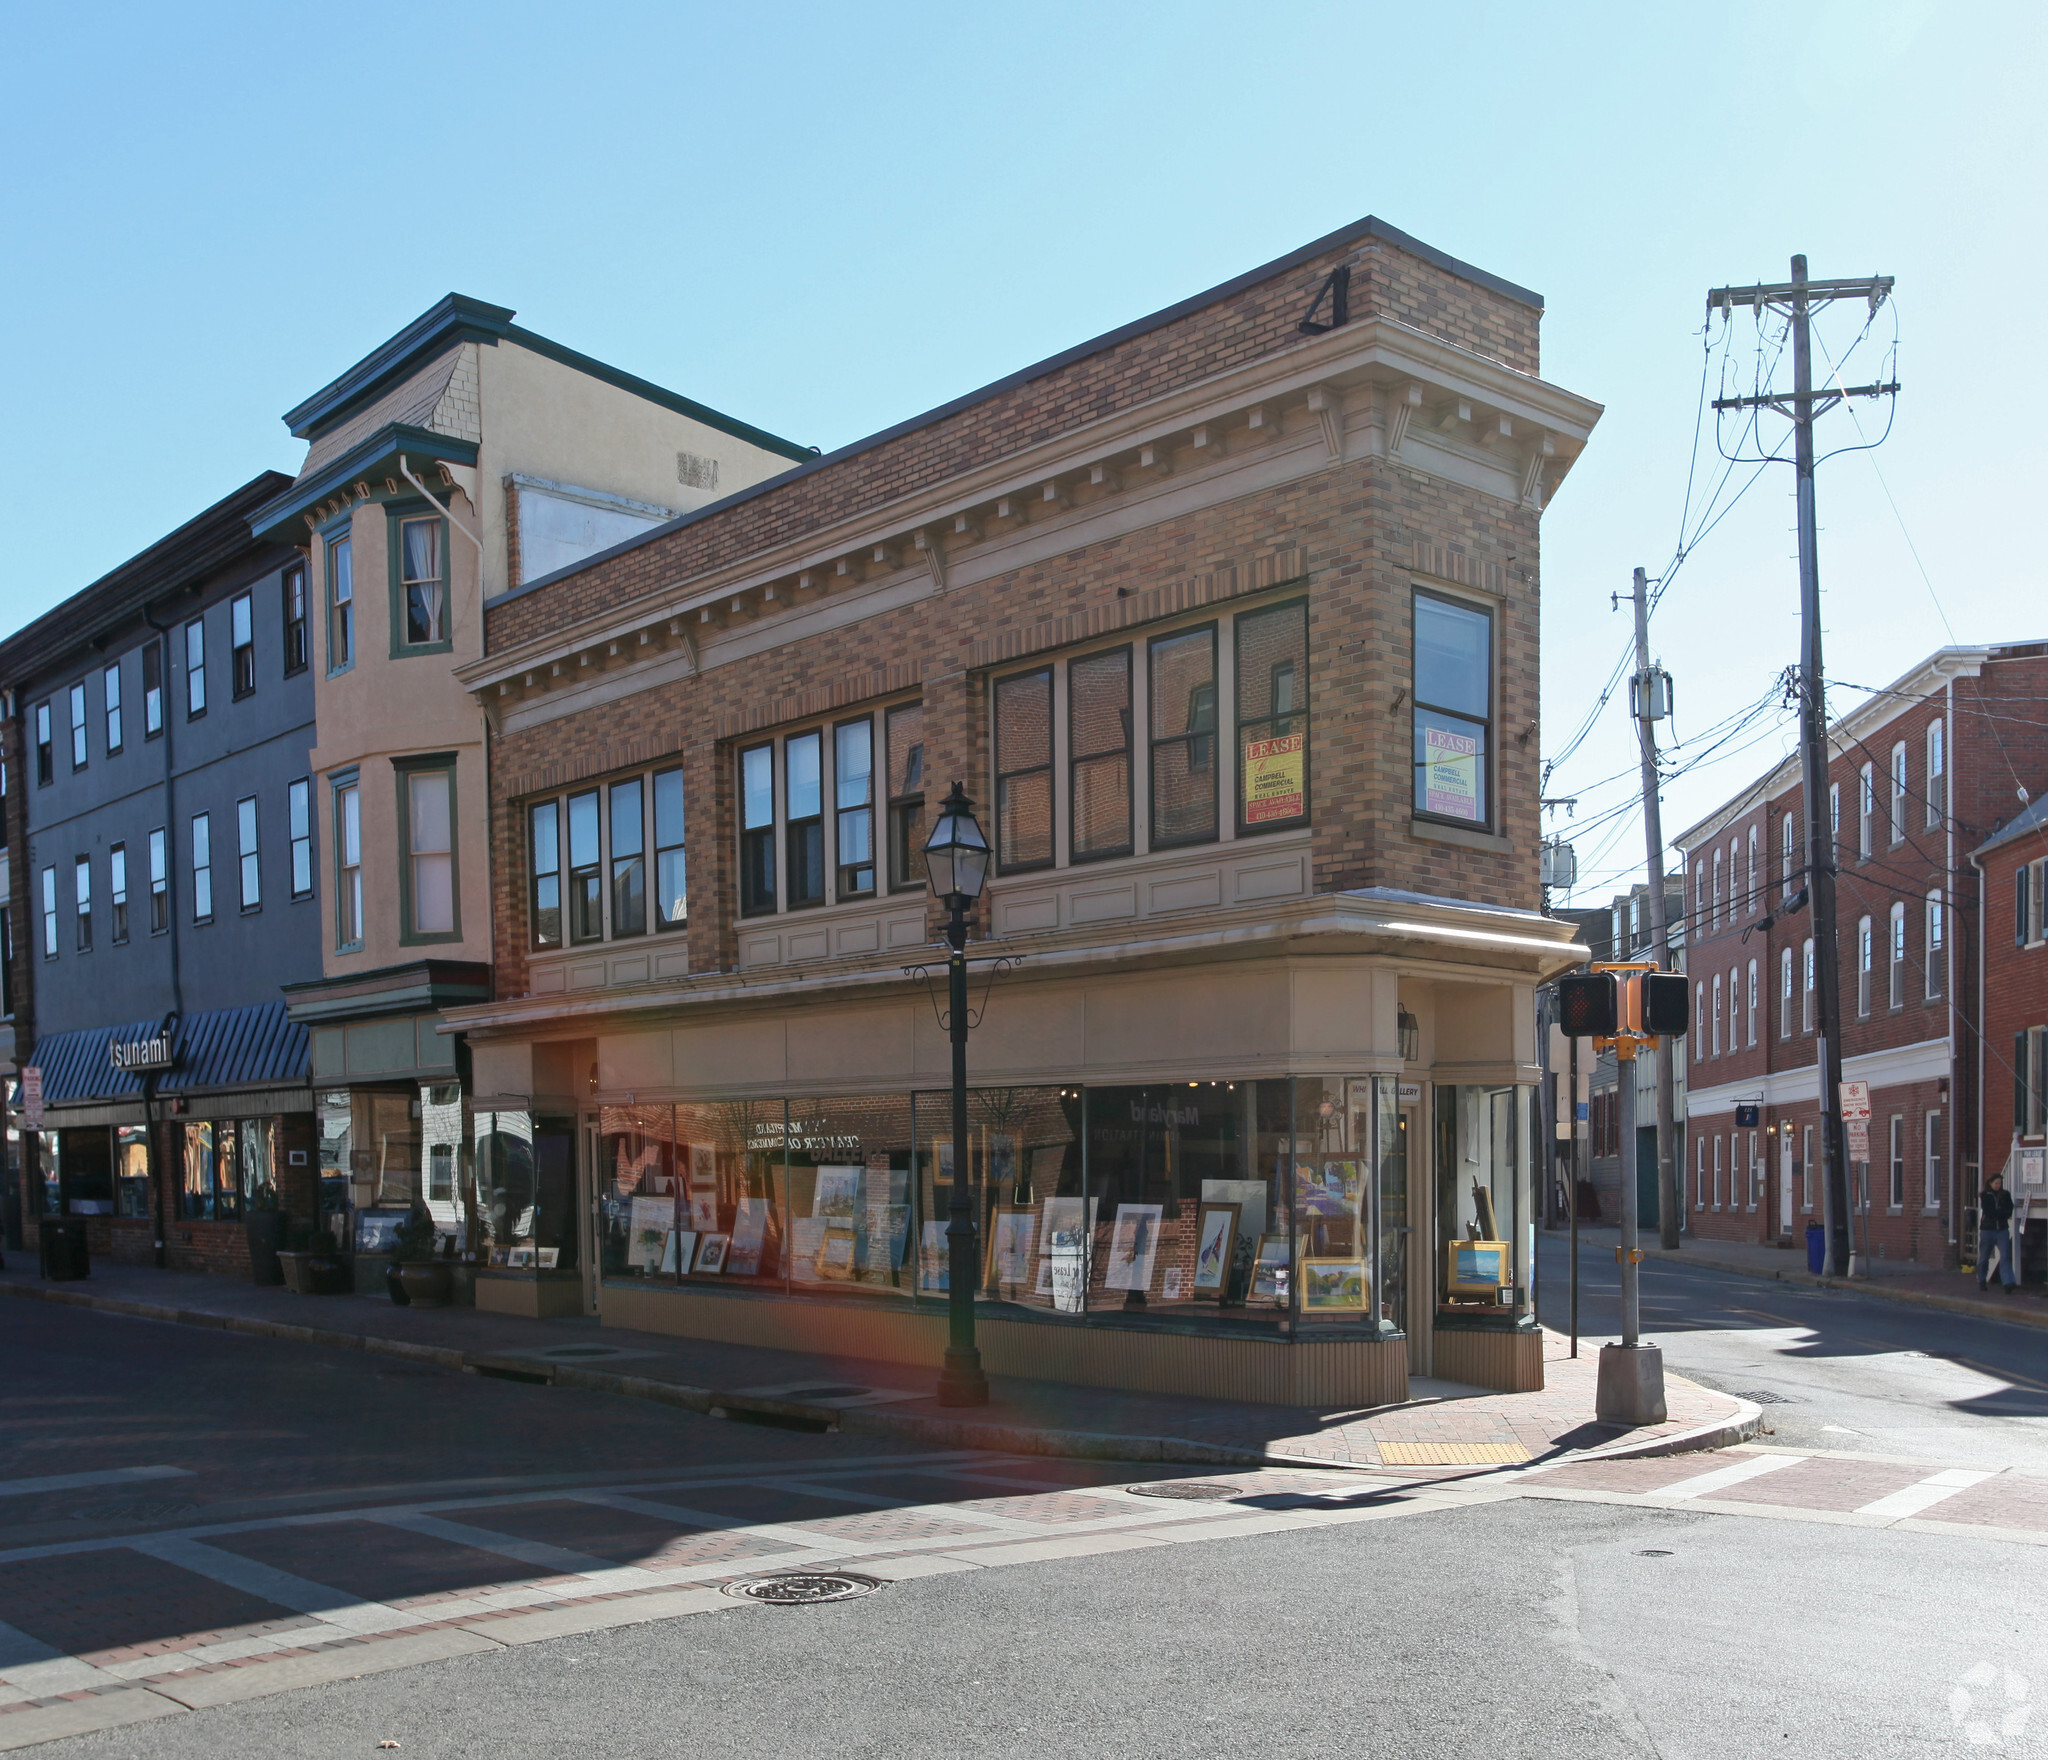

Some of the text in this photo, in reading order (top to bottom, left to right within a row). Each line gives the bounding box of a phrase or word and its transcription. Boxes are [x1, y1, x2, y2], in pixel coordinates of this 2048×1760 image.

[1249, 736, 1300, 759] LEASE
[1428, 731, 1474, 754] LEASE
[1255, 771, 1286, 783] CAMPBELL
[1434, 765, 1461, 777] CAMPBELL
[1255, 778, 1294, 791] COMMERCIAL
[1434, 773, 1468, 786] COMMERCIAL
[110, 1030, 167, 1067] tsunami
[1391, 1087, 1419, 1096] GLLERY
